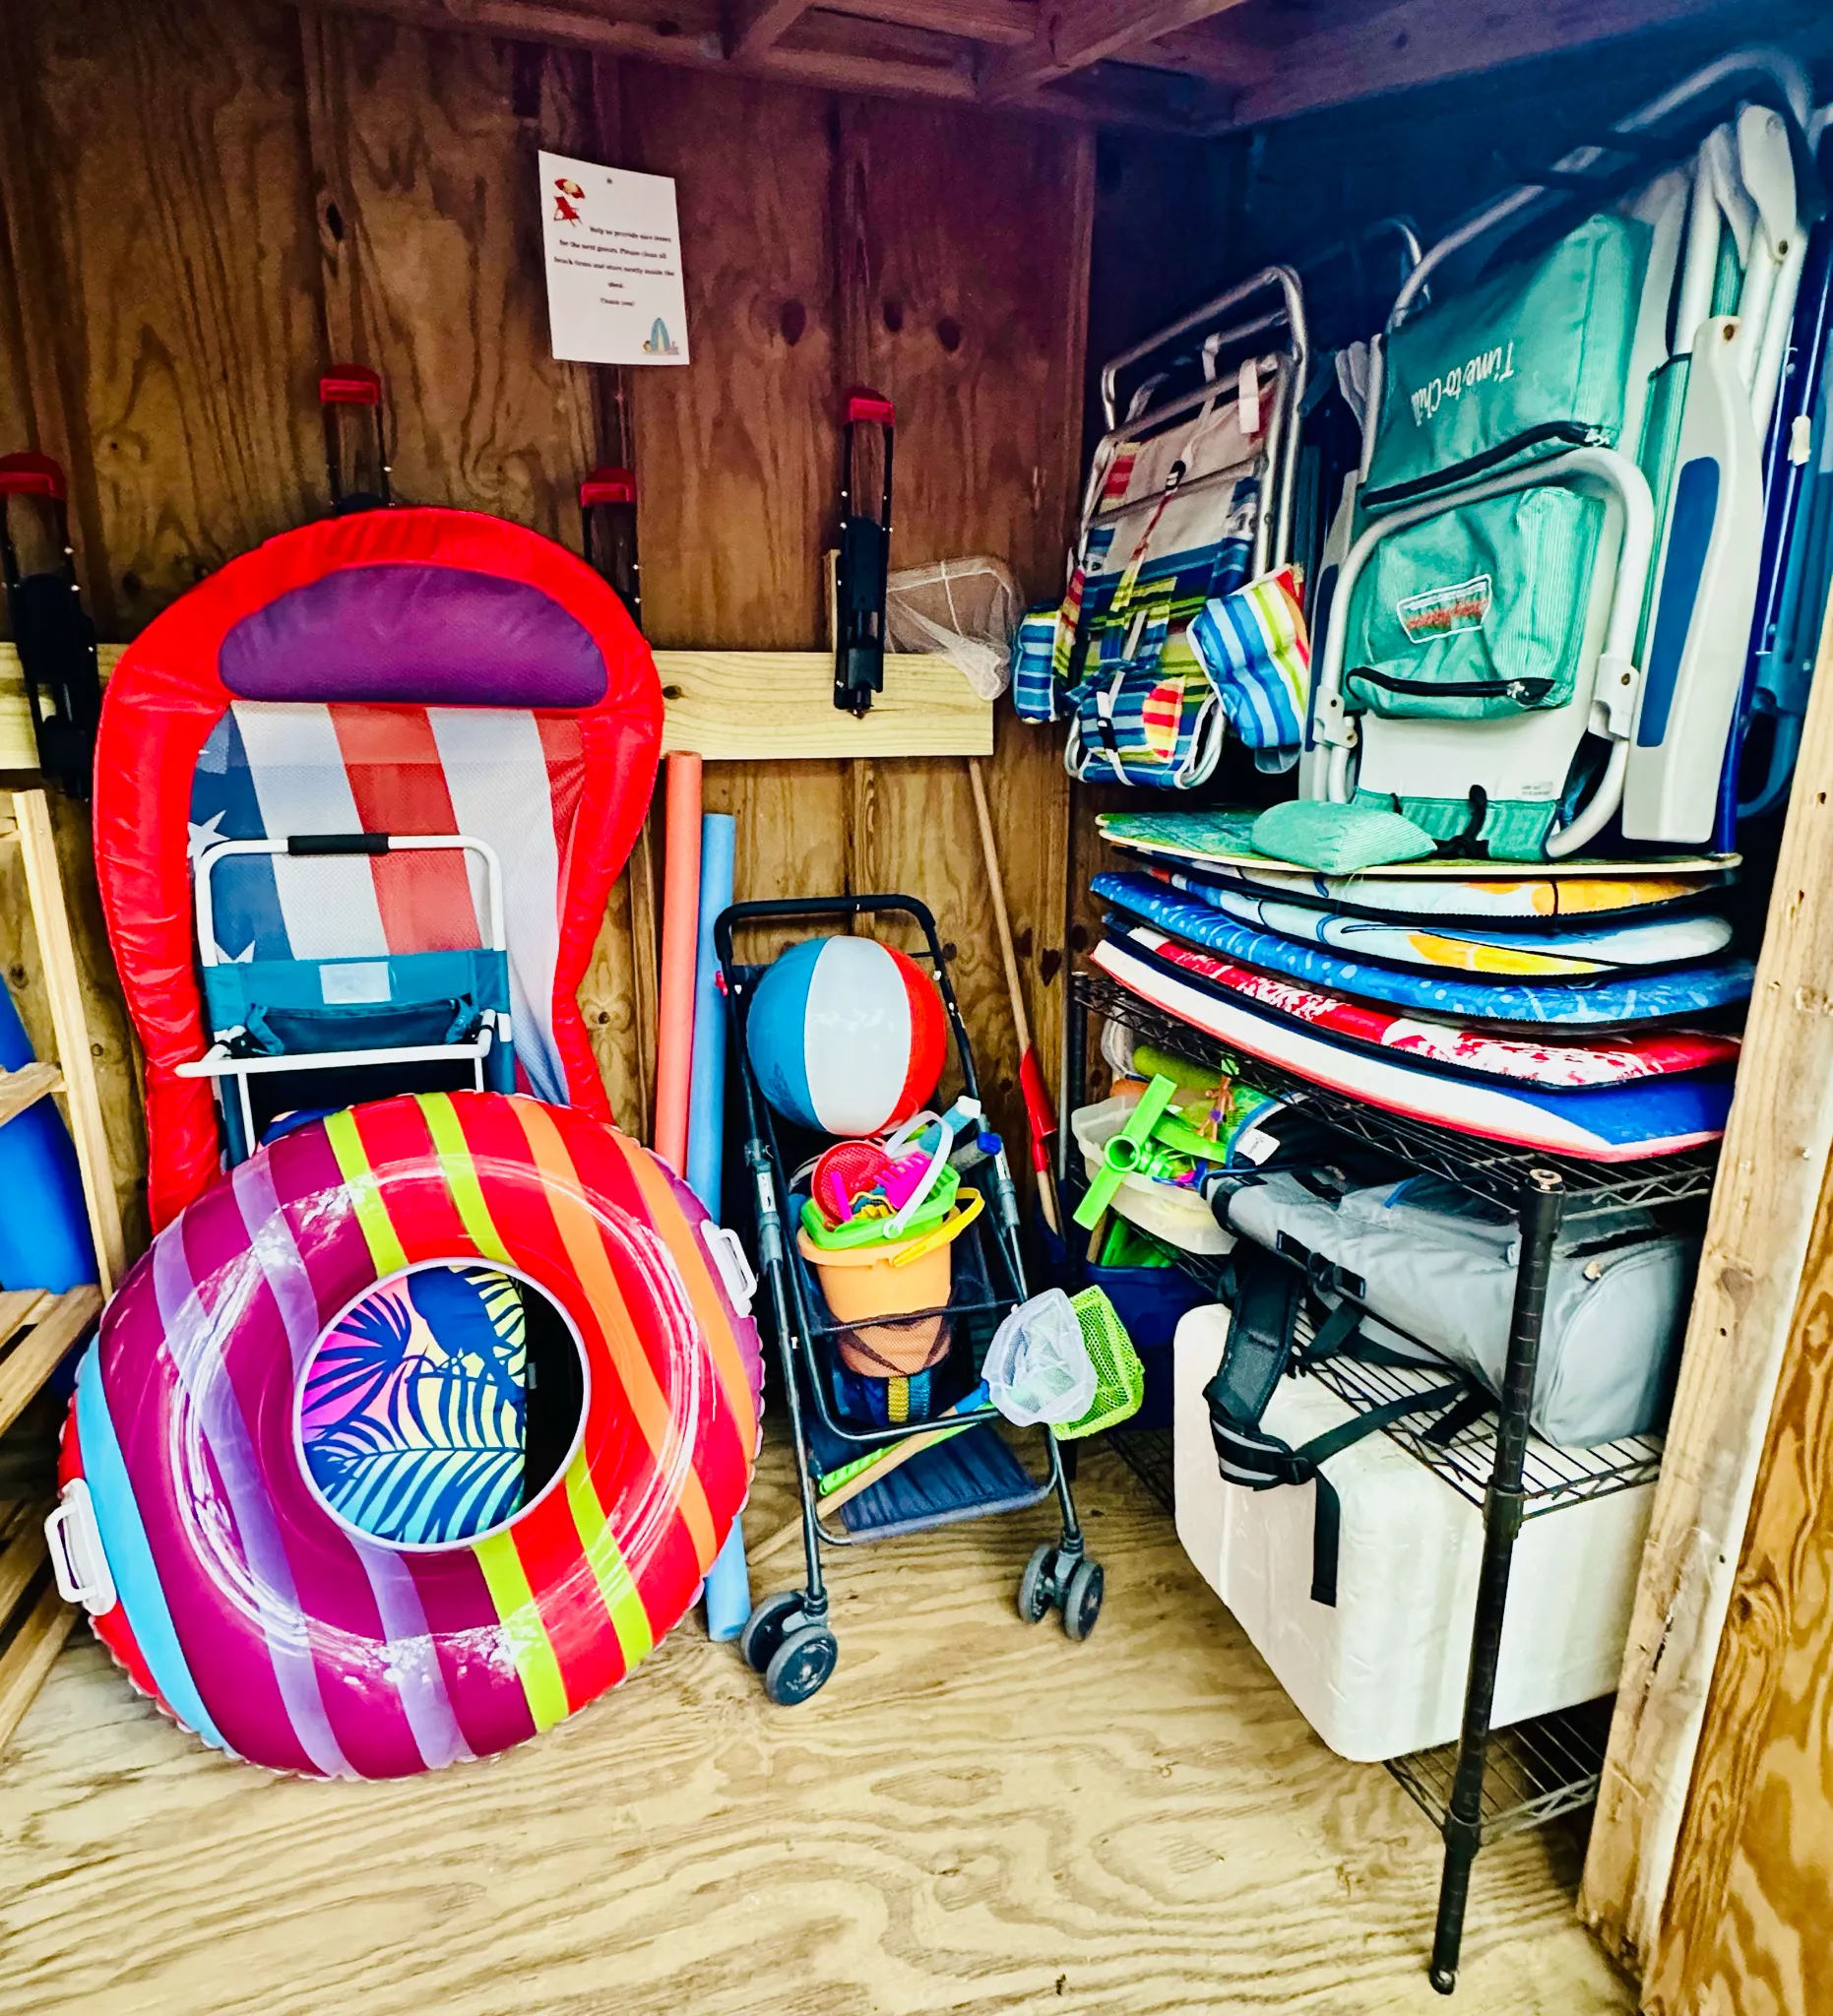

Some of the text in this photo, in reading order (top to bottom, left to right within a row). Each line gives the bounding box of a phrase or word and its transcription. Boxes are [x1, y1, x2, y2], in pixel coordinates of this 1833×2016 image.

[553, 256, 573, 265] beach
[600, 296, 620, 306] Thank
[1462, 338, 1515, 387] Time
[1441, 366, 1463, 402] to
